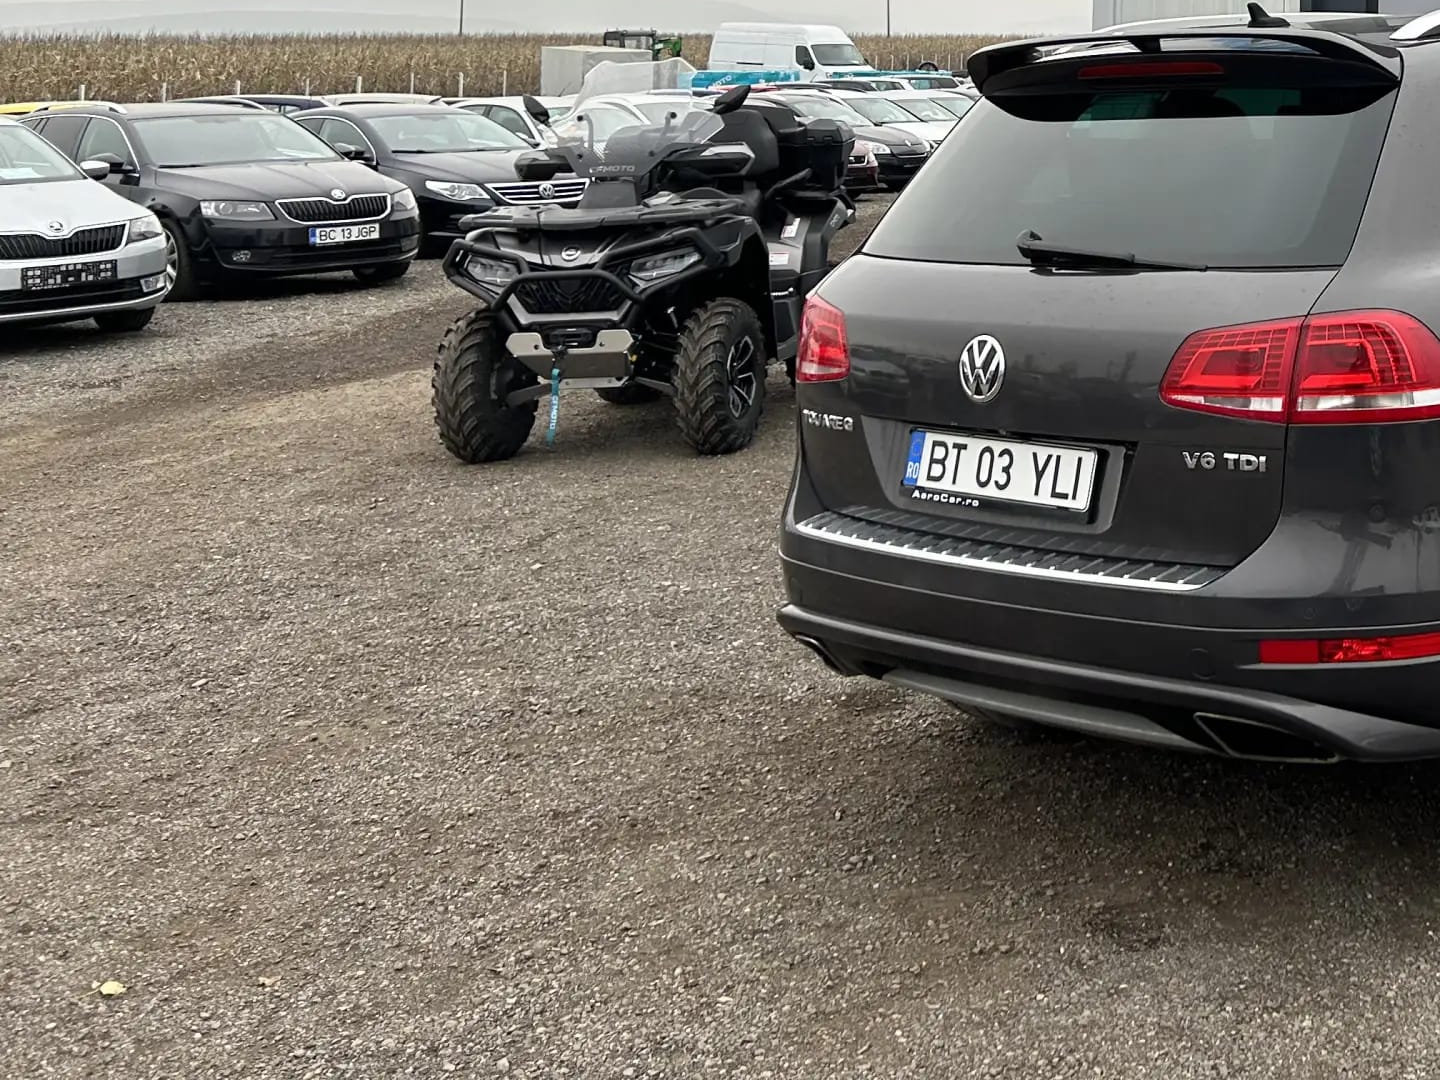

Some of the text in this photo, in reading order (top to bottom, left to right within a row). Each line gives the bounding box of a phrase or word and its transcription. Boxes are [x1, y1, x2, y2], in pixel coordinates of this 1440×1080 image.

[319, 225, 377, 241] BC 13 JGP
[905, 461, 920, 479] RO
[926, 439, 1083, 501] BT 03 YLI
[1182, 451, 1267, 472] V6 TDI
[911, 489, 980, 508] AeroCar.ro
